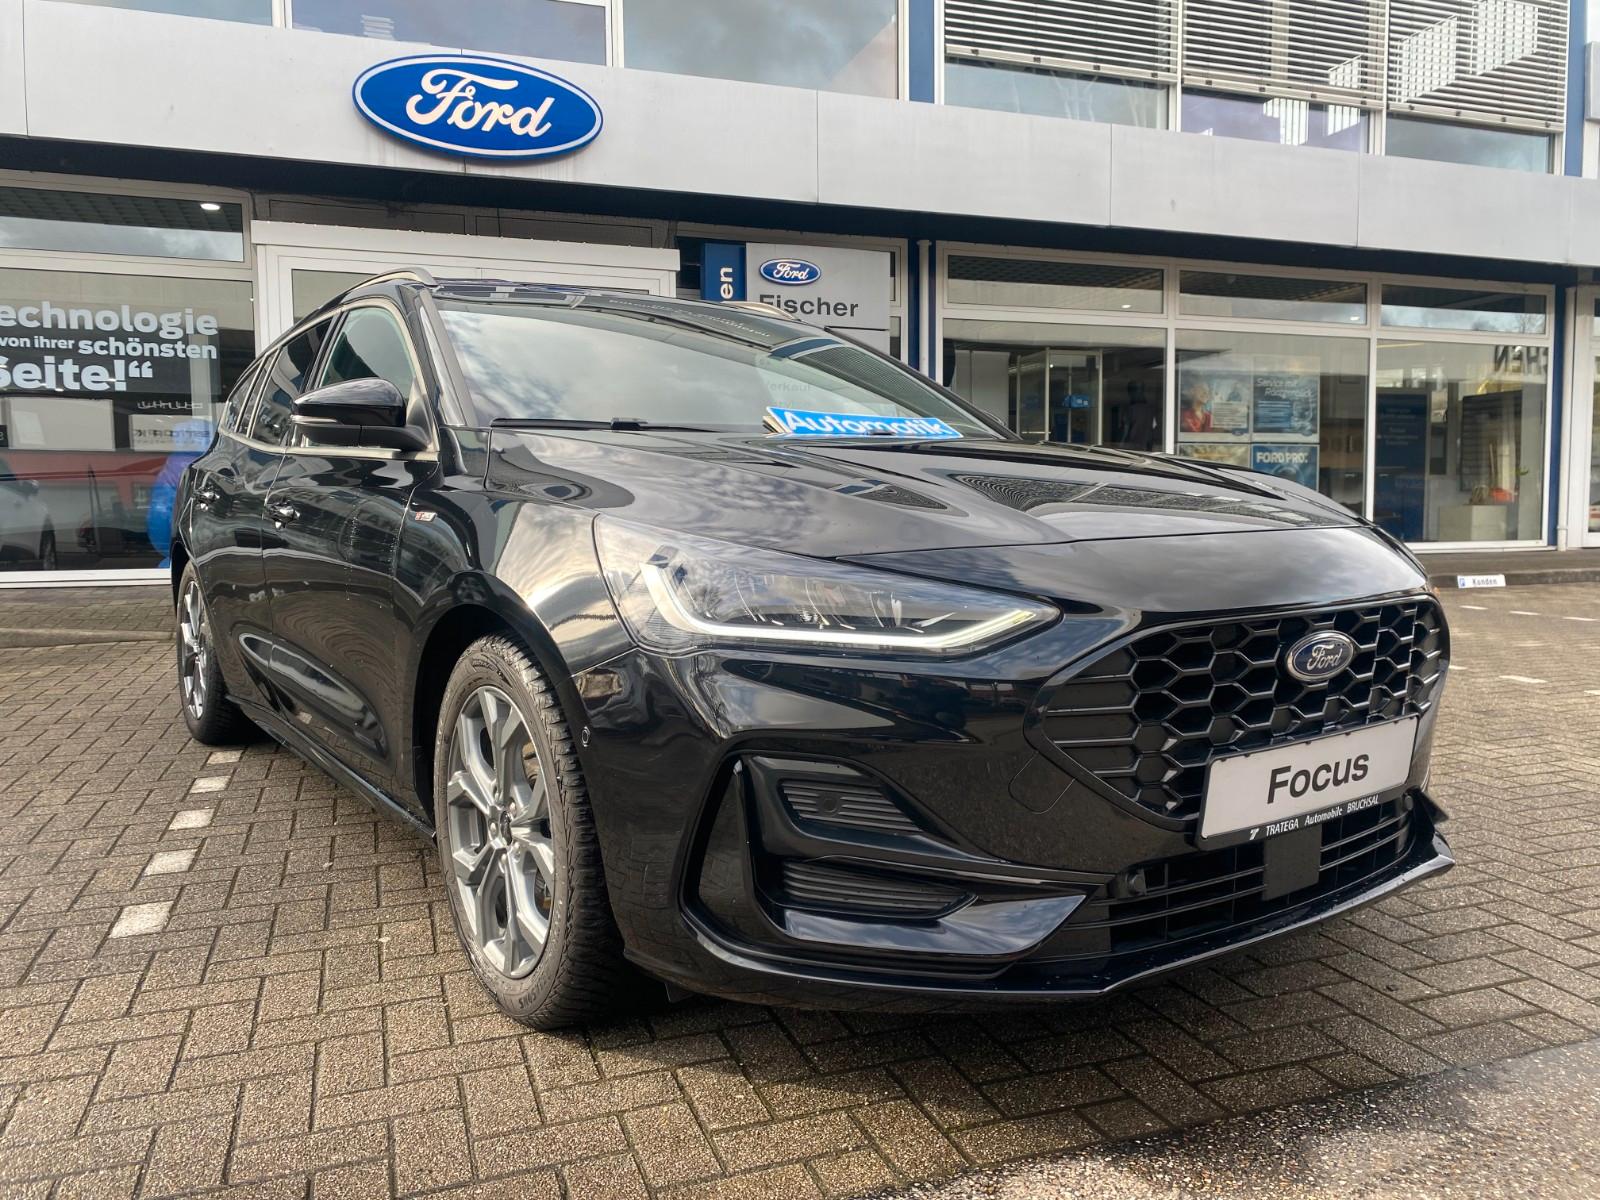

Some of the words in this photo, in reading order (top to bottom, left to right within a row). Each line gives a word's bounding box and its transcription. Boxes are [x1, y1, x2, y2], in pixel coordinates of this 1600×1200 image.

[405, 68, 556, 138] Ford
[772, 262, 809, 280] Ford
[0, 335, 31, 348] von
[34, 336, 75, 349] ihrer
[78, 337, 218, 359] schönsten
[783, 410, 952, 436] Automatik
[1256, 451, 1285, 463] FORD
[1306, 643, 1344, 671] Ford
[1266, 753, 1370, 805] Focus
[1265, 818, 1299, 838] TRATEGA
[1304, 805, 1343, 827] Automobile
[1346, 793, 1380, 814] BRUCHSAL
